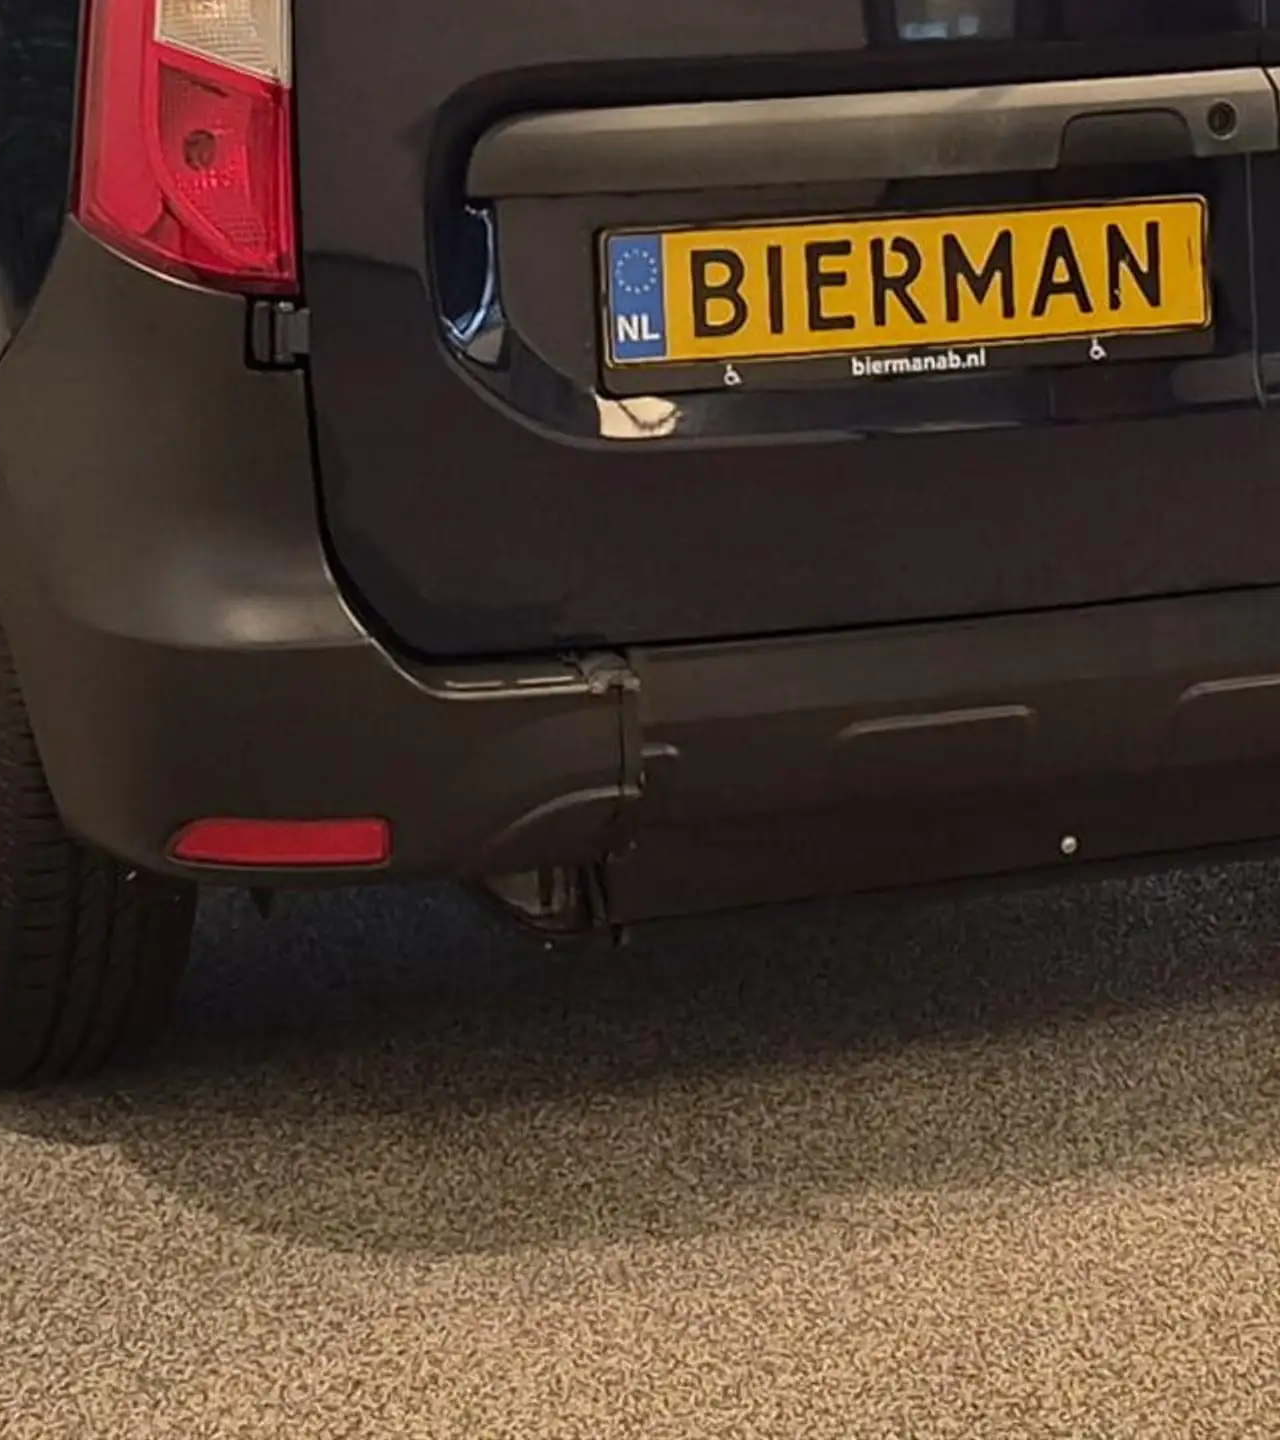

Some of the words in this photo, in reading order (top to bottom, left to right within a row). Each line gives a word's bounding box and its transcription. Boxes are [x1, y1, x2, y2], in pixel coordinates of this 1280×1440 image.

[617, 313, 661, 343] NL
[689, 221, 1162, 339] BIERMAN
[851, 346, 987, 376] biermanab.nl
